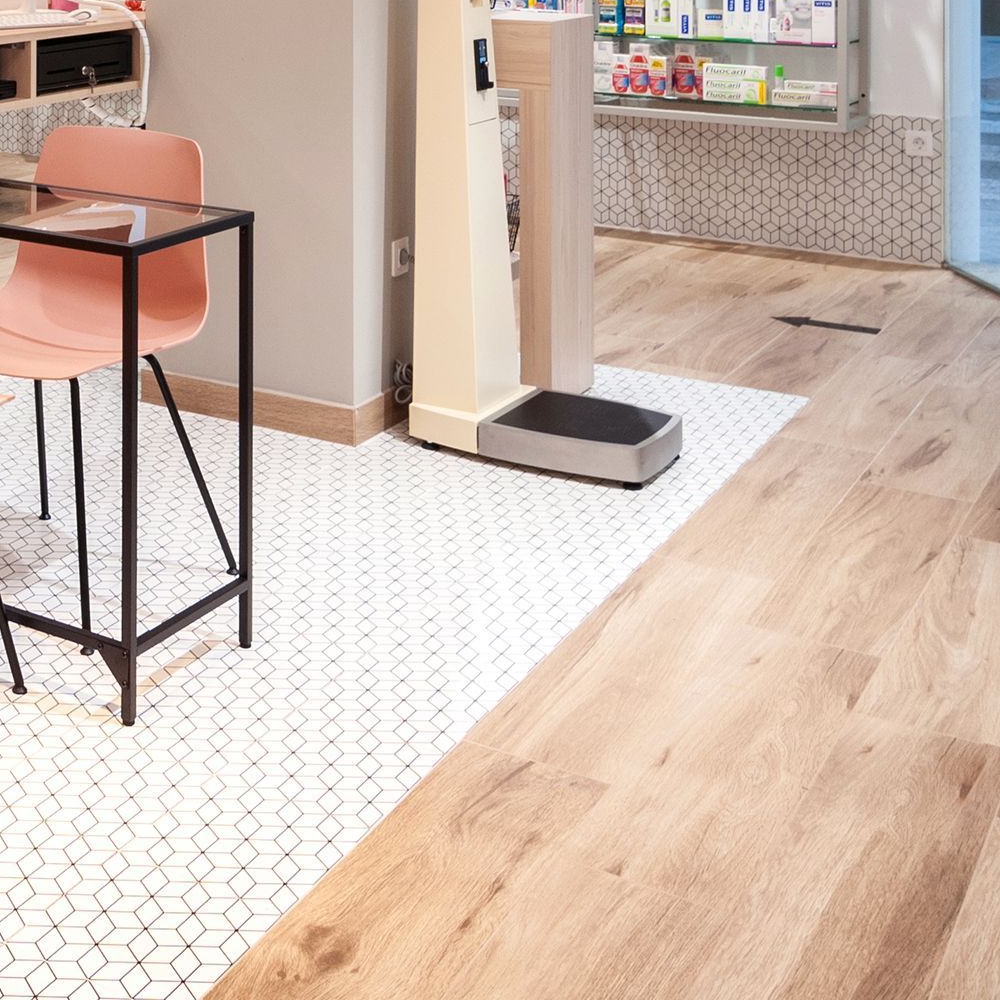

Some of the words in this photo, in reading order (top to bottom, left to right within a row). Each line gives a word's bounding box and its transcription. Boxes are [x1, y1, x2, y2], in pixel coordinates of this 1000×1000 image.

[705, 67, 746, 75] Fluocaril
[706, 91, 741, 99] Fluocaril
[773, 91, 811, 101] Fluocaril
